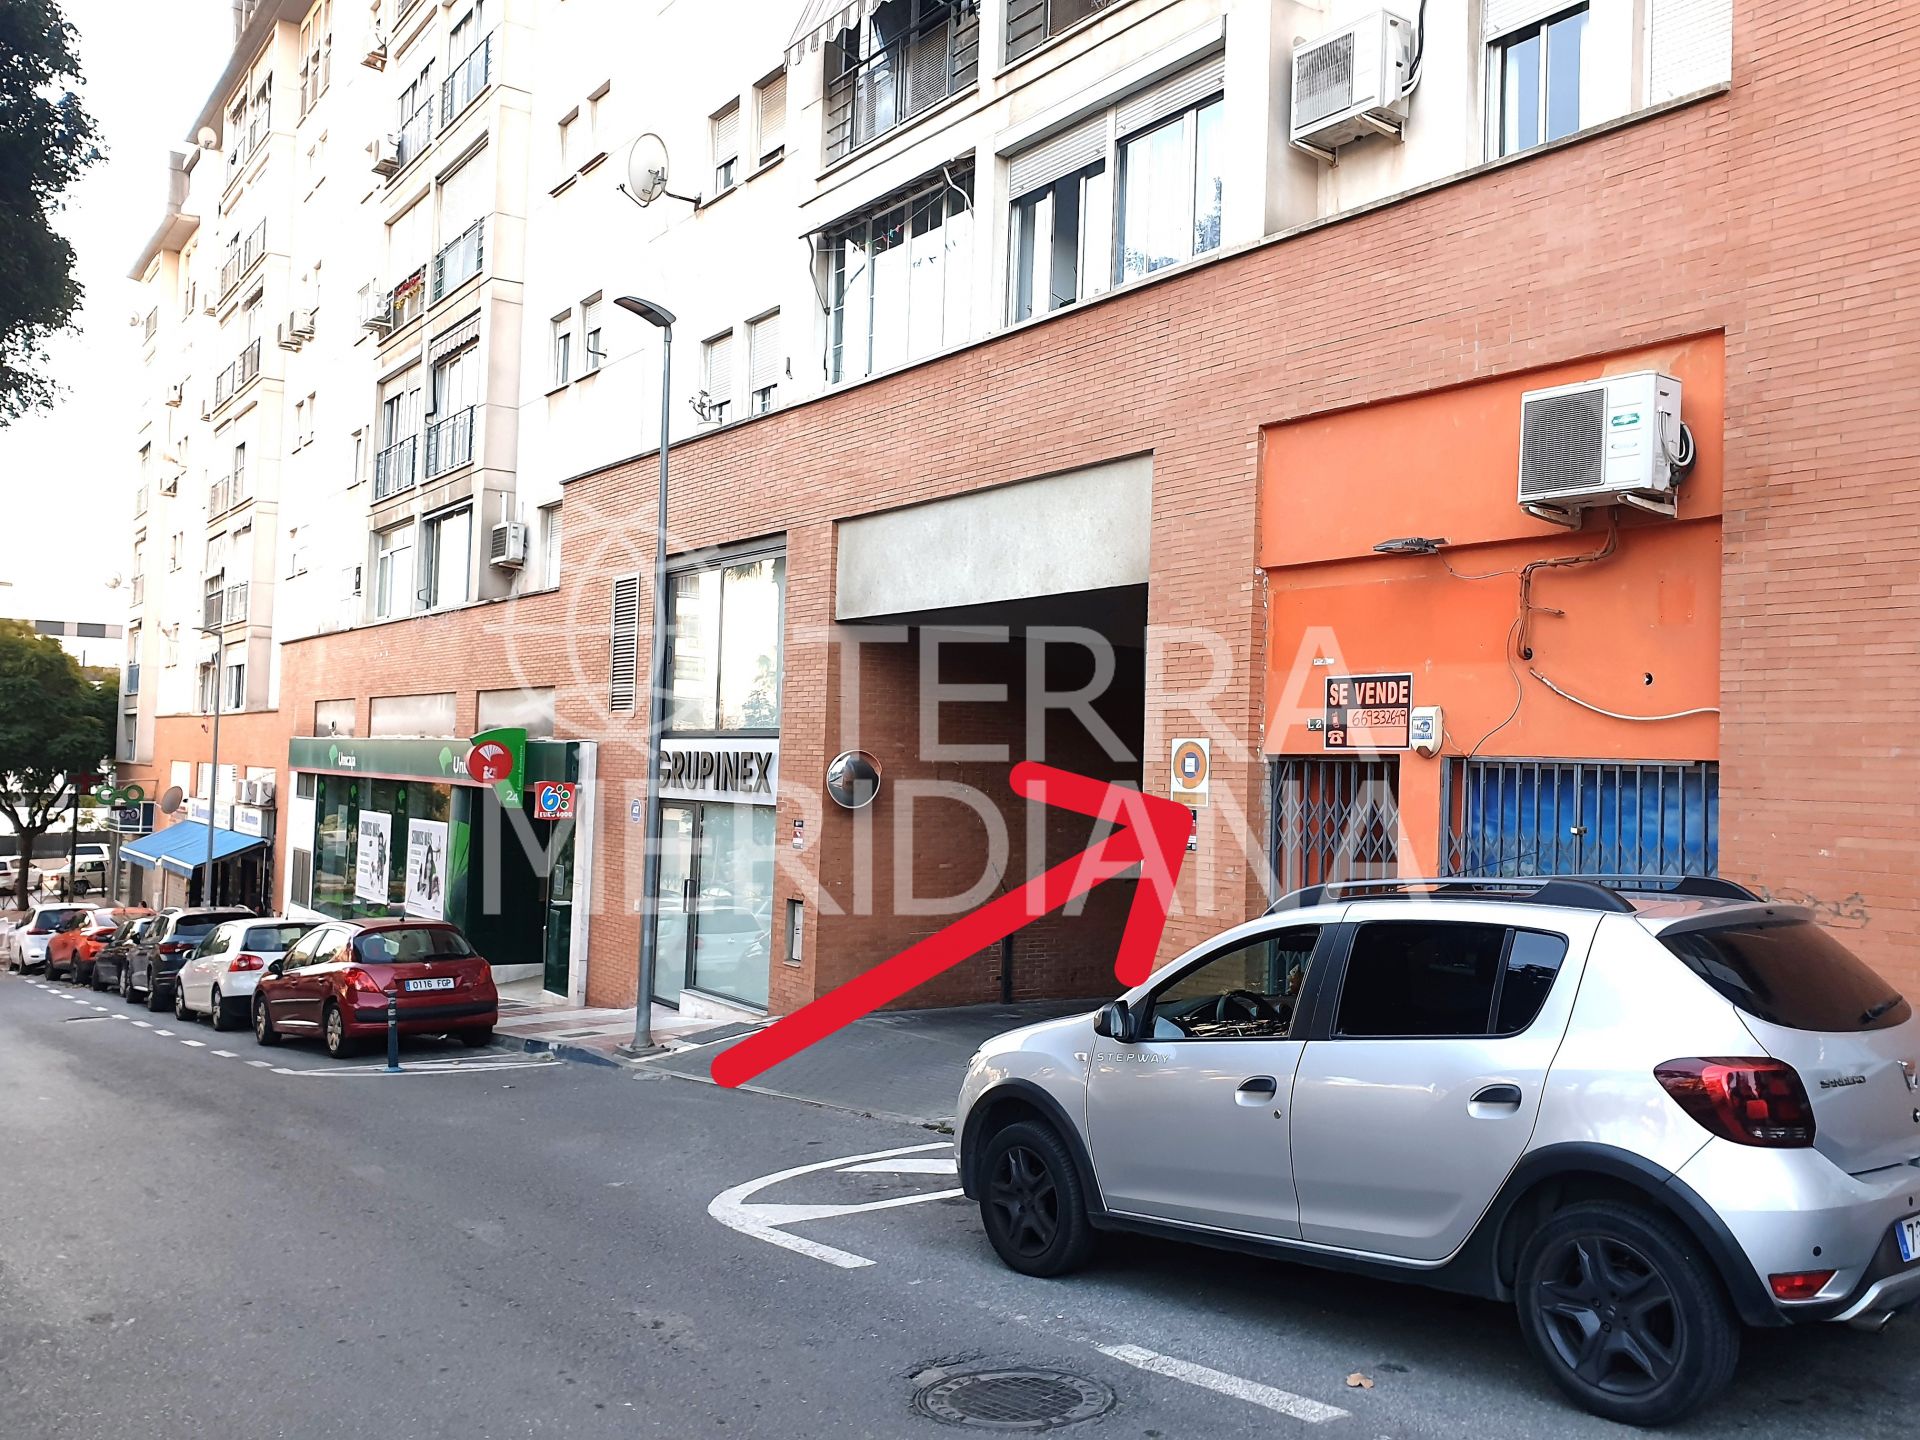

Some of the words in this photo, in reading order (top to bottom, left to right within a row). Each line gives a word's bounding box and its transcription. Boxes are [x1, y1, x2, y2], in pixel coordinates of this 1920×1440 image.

[1329, 683, 1348, 705] SE
[1355, 681, 1408, 705] VENDE
[658, 750, 772, 793] GRUPINEX
[505, 790, 519, 804] 24
[412, 980, 433, 989] 0116
[1097, 1052, 1169, 1064] STEPWAY
